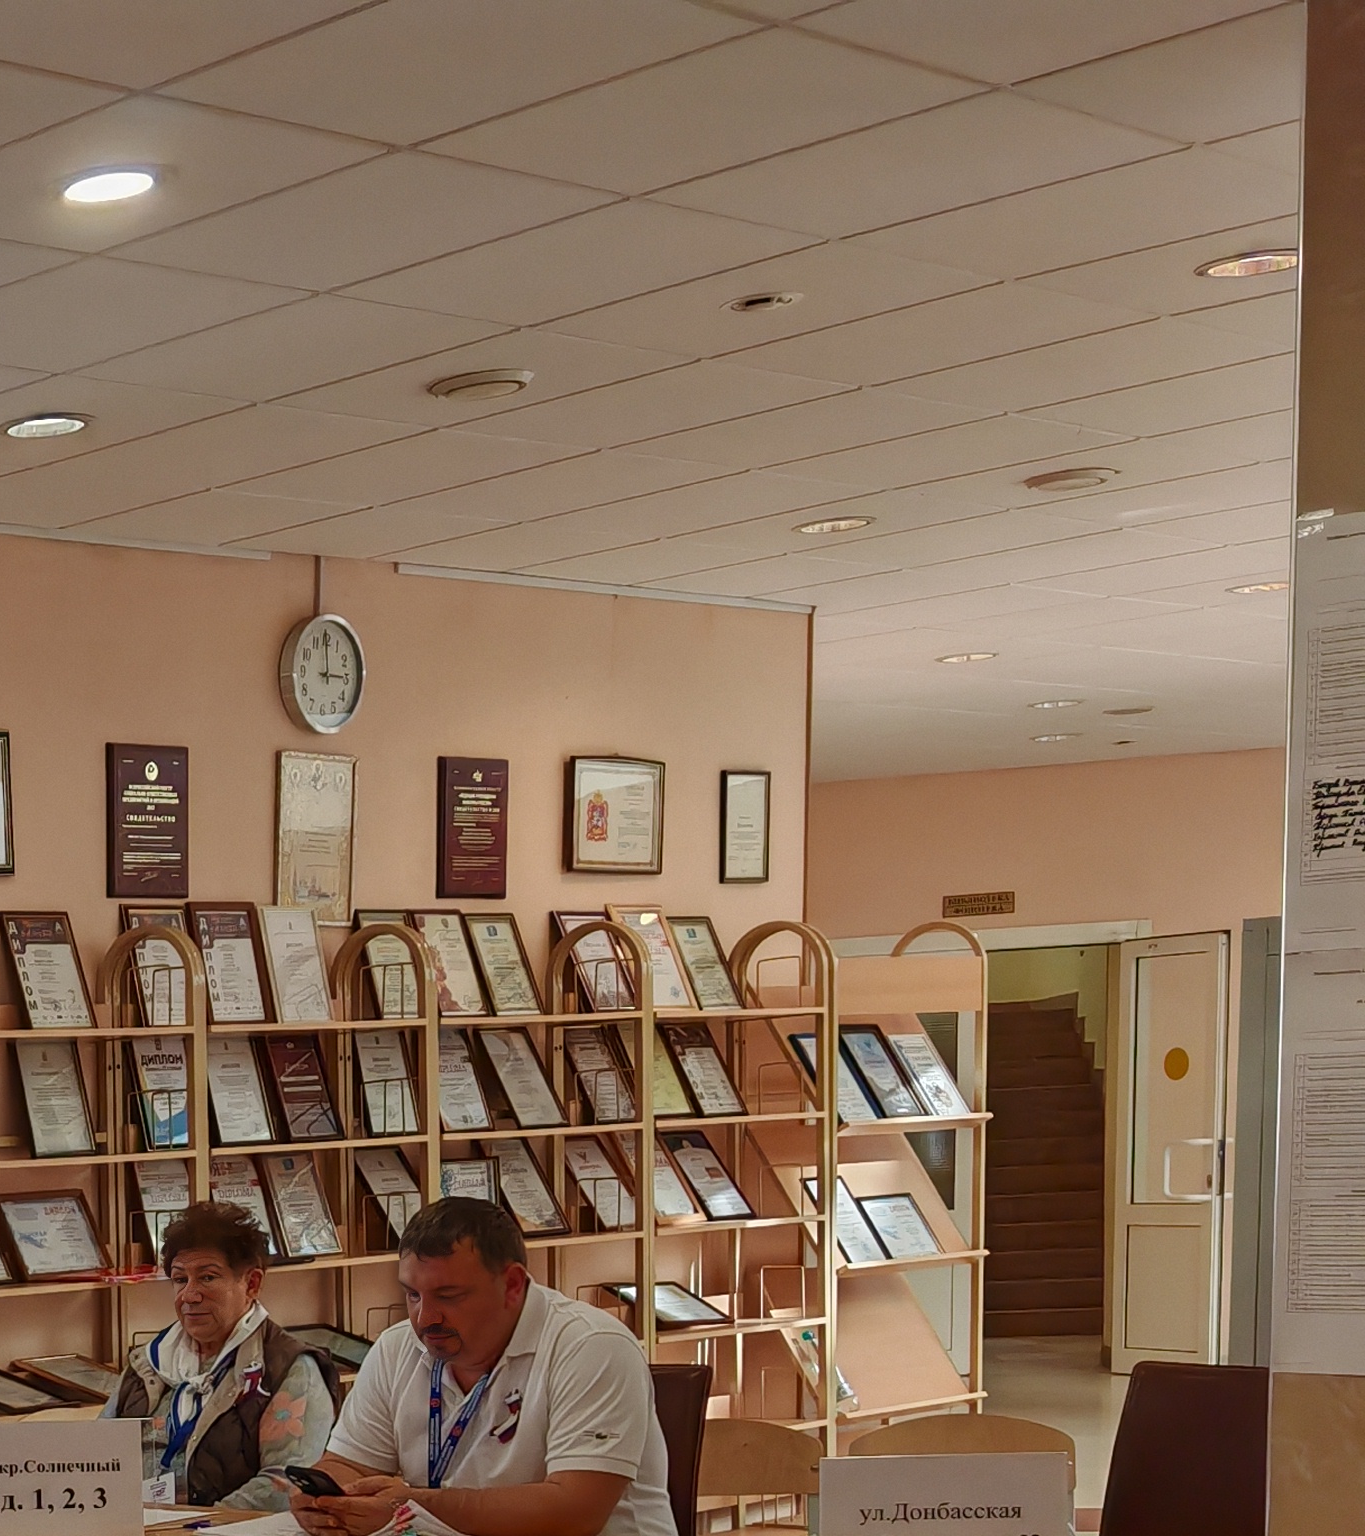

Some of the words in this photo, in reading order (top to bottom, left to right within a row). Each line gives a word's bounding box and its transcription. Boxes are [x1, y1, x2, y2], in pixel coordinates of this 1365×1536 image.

[312, 635, 319, 650] 11
[335, 640, 339, 653] 1
[302, 648, 311, 661] 10
[341, 654, 348, 668] 2
[300, 664, 306, 678] 9
[342, 673, 350, 685] 3
[302, 683, 308, 697] 8
[338, 690, 345, 702] 4
[309, 698, 315, 711] 7
[320, 703, 326, 716] 6
[330, 702, 336, 714] 5
[141, 1054, 183, 1067] ДИПЛОМ
[1, 1495, 23, 1513] д.
[33, 1489, 55, 1514] 1,
[62, 1488, 85, 1514] 2,
[93, 1487, 107, 1509] 3
[859, 1503, 1022, 1525] ул.Донбасская
